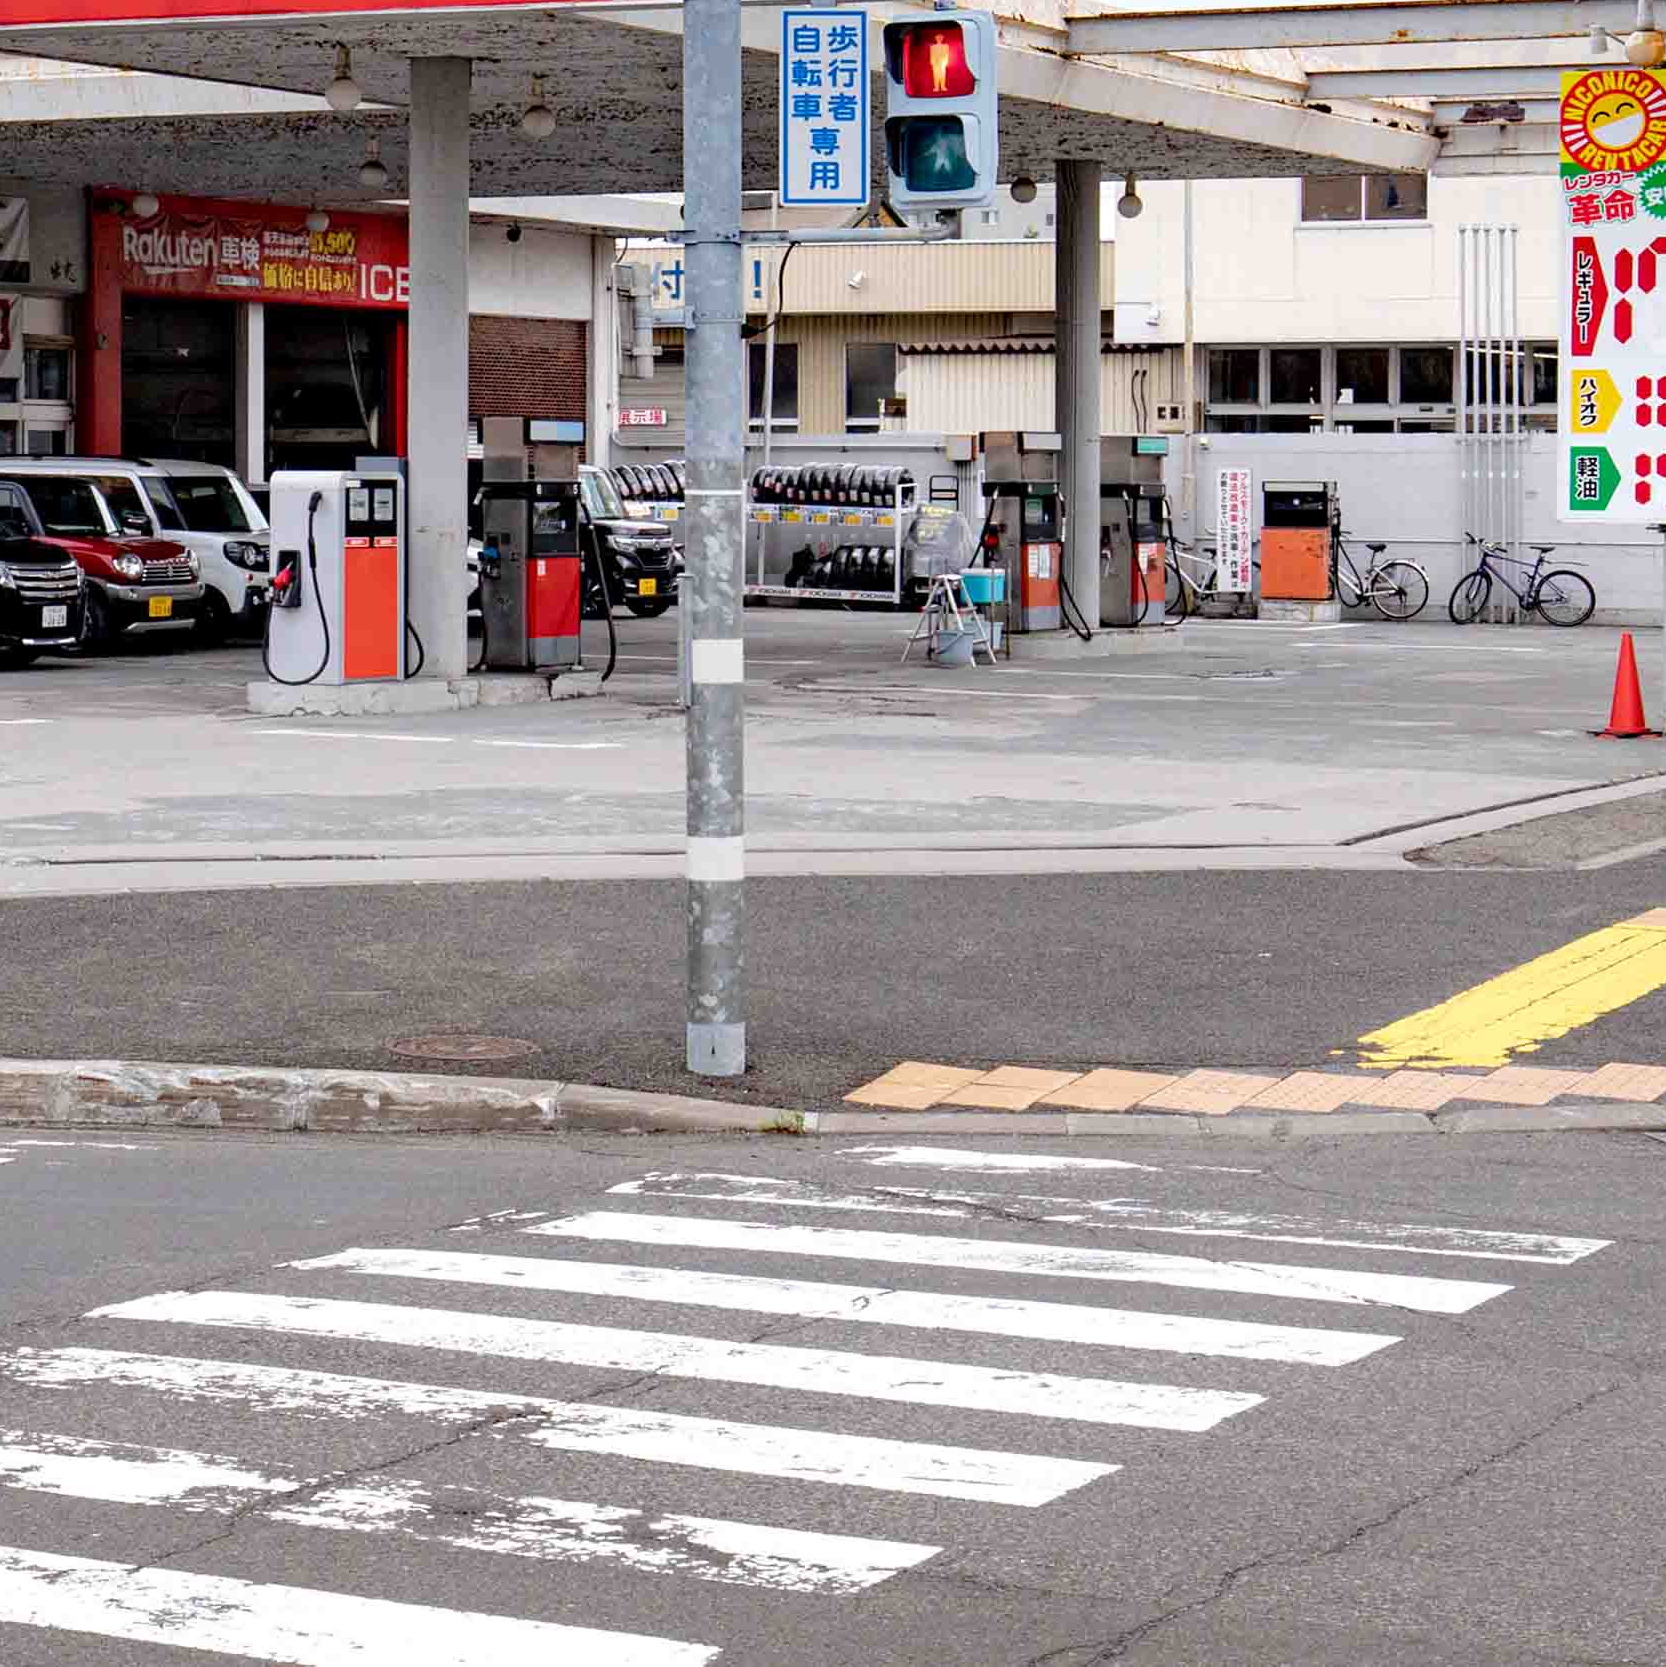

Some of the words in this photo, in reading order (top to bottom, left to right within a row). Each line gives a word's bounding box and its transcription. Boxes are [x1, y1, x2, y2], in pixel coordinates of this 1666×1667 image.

[791, 24, 823, 122] 自転車
[827, 24, 859, 122] 歩行者
[1564, 70, 1653, 120] NICONICO
[809, 127, 841, 192] 専用
[1564, 171, 1636, 190] レンタカー
[1567, 188, 1638, 226] 革命
[122, 225, 218, 268] Rakuten
[220, 234, 260, 271] 車検
[1577, 251, 1592, 342] レギュラー
[1580, 377, 1597, 427] ハイオク
[1577, 456, 1598, 500] 軽油
